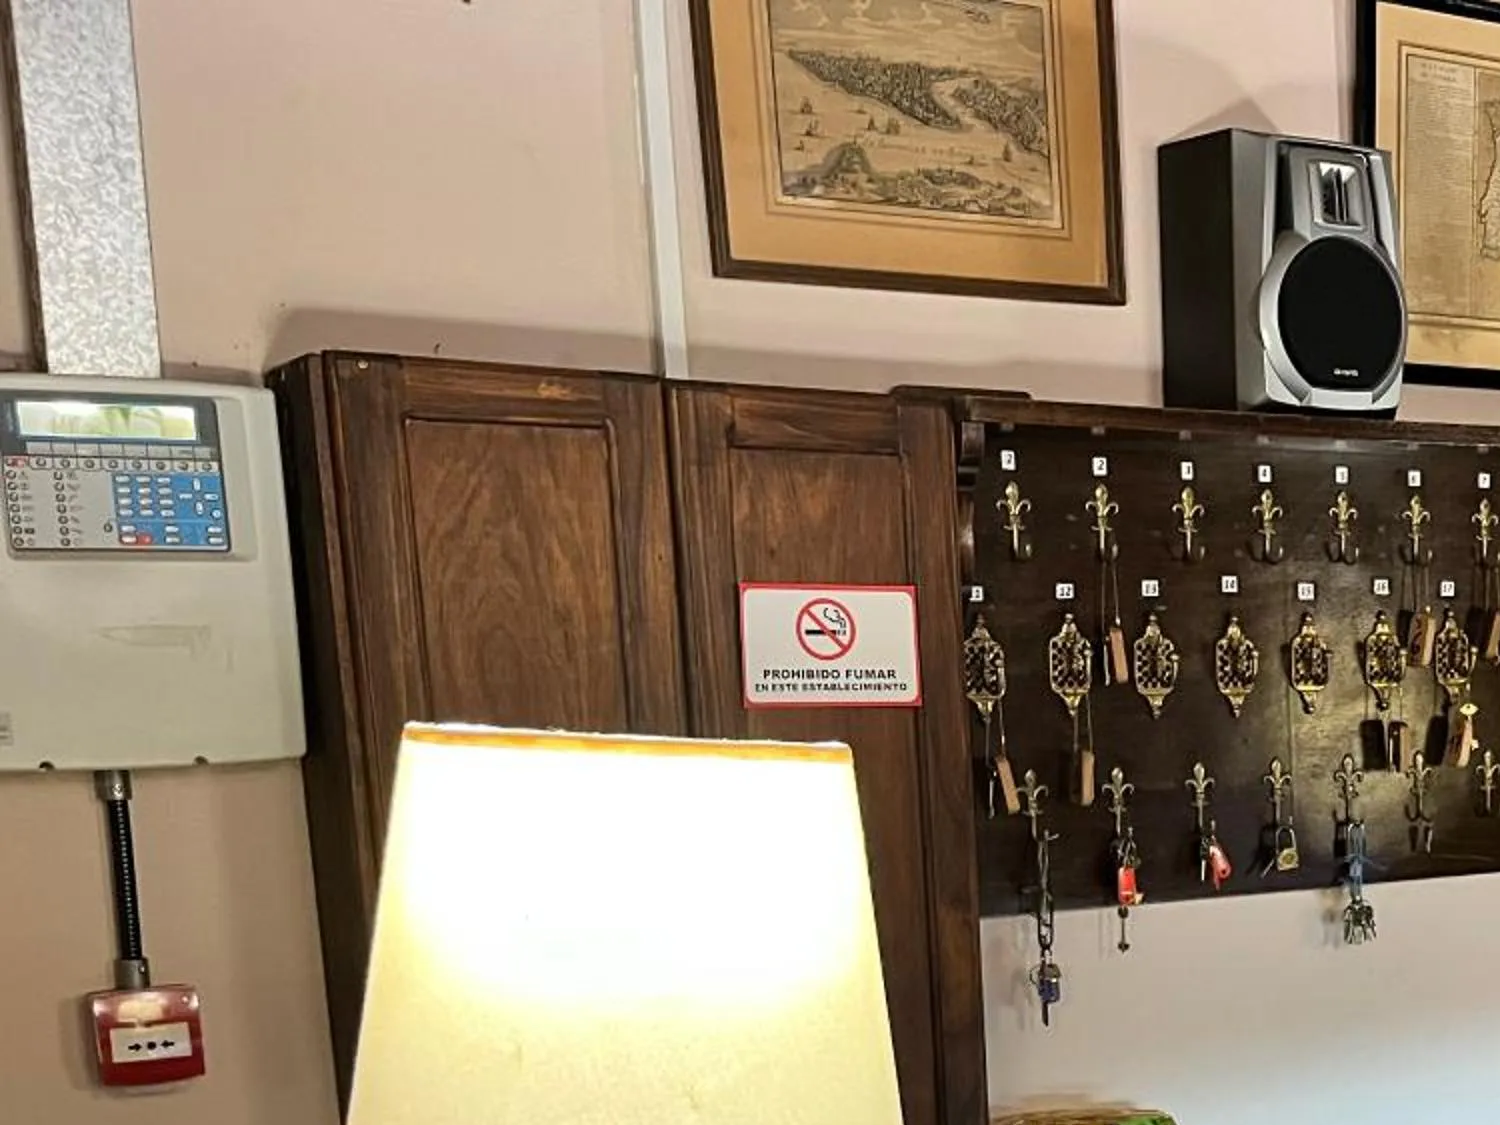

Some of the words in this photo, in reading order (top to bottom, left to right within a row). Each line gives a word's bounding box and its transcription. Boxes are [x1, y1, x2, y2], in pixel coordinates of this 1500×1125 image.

[763, 669, 841, 680] PROHIBIDO
[845, 669, 897, 680] FUMAR
[755, 682, 769, 692] EN
[771, 683, 798, 692] ESTE
[801, 682, 908, 692] ESTABLECIMIENTO
